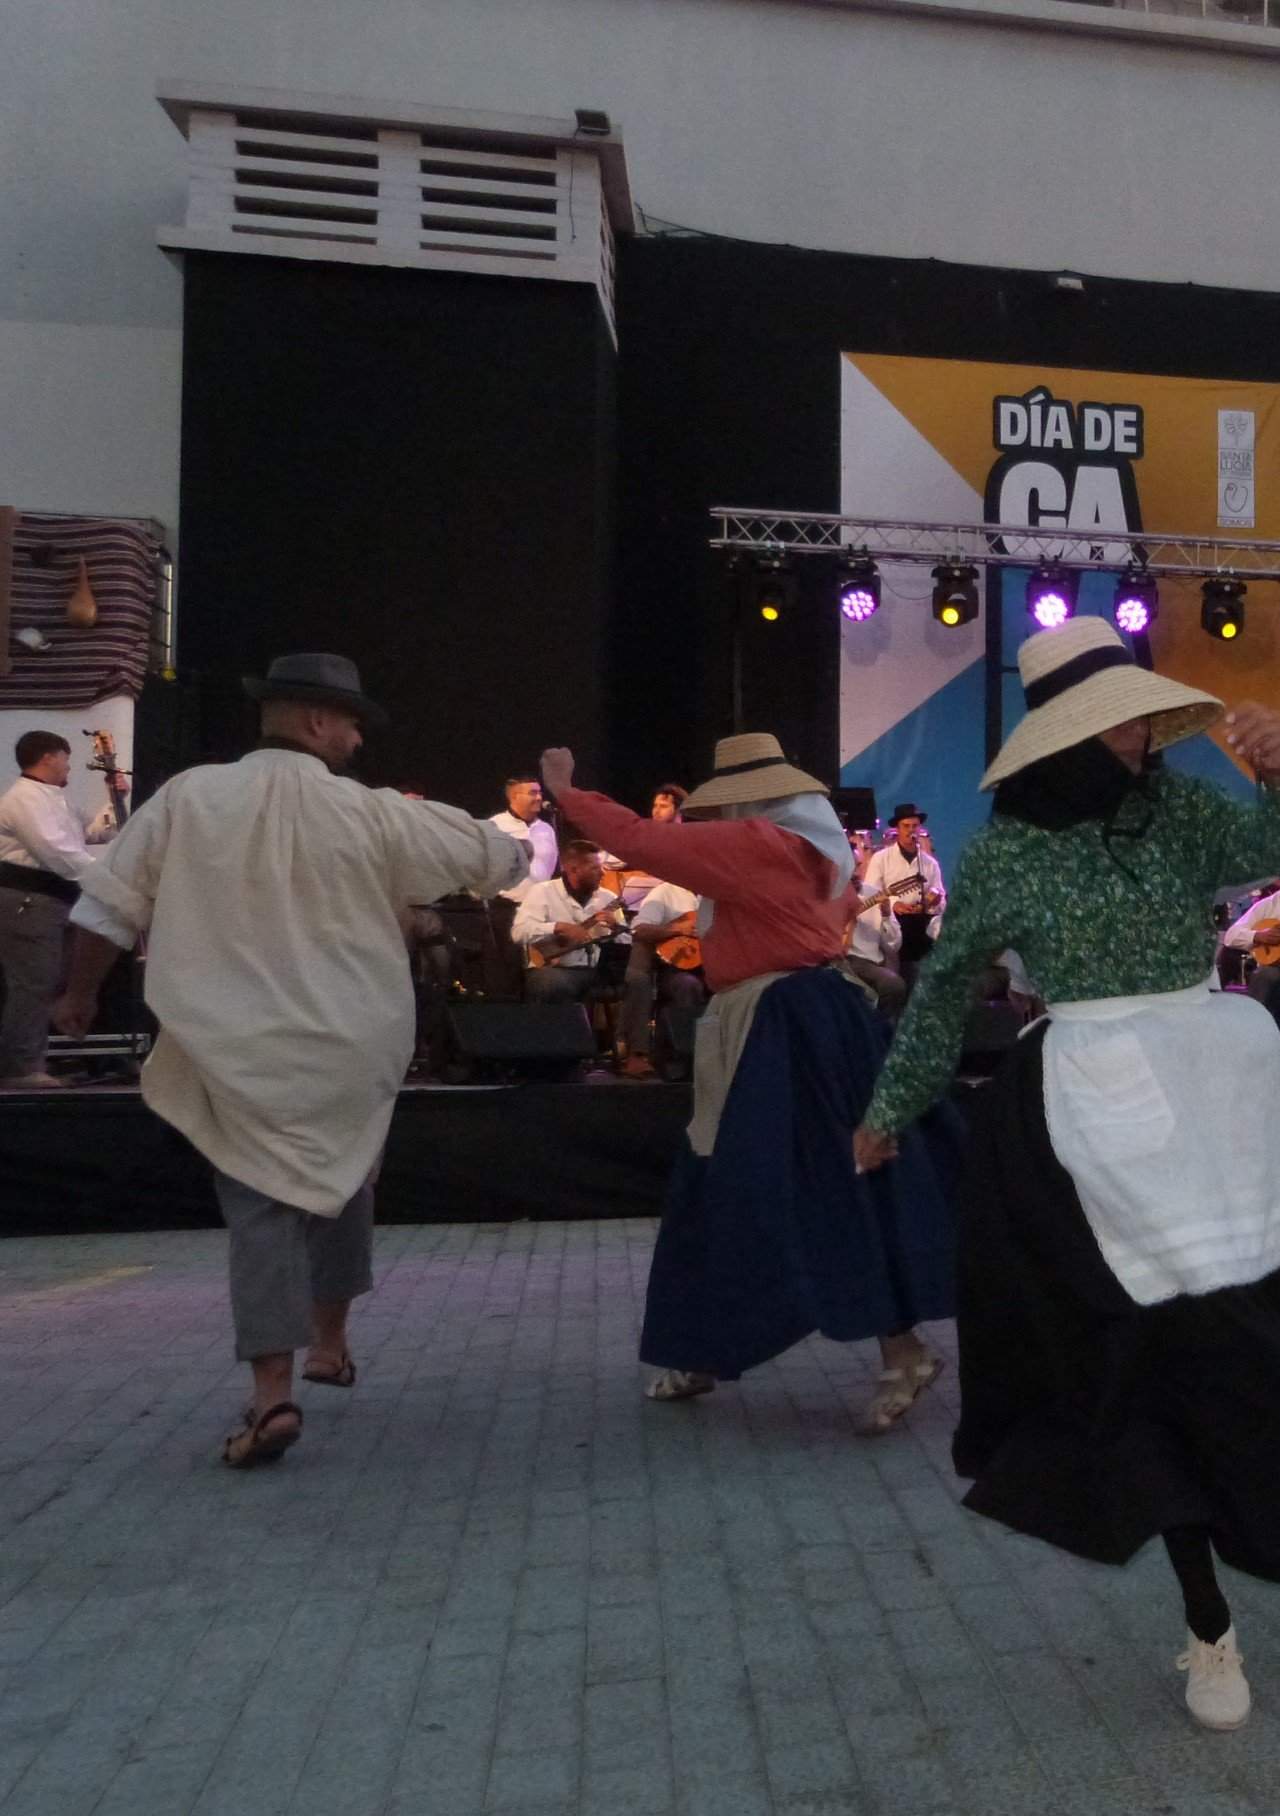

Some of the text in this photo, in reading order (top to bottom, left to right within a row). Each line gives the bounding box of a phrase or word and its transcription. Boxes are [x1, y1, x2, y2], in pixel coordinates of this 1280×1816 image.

[1000, 393, 1137, 453] DÍA DE
[1000, 462, 1135, 567] CA
